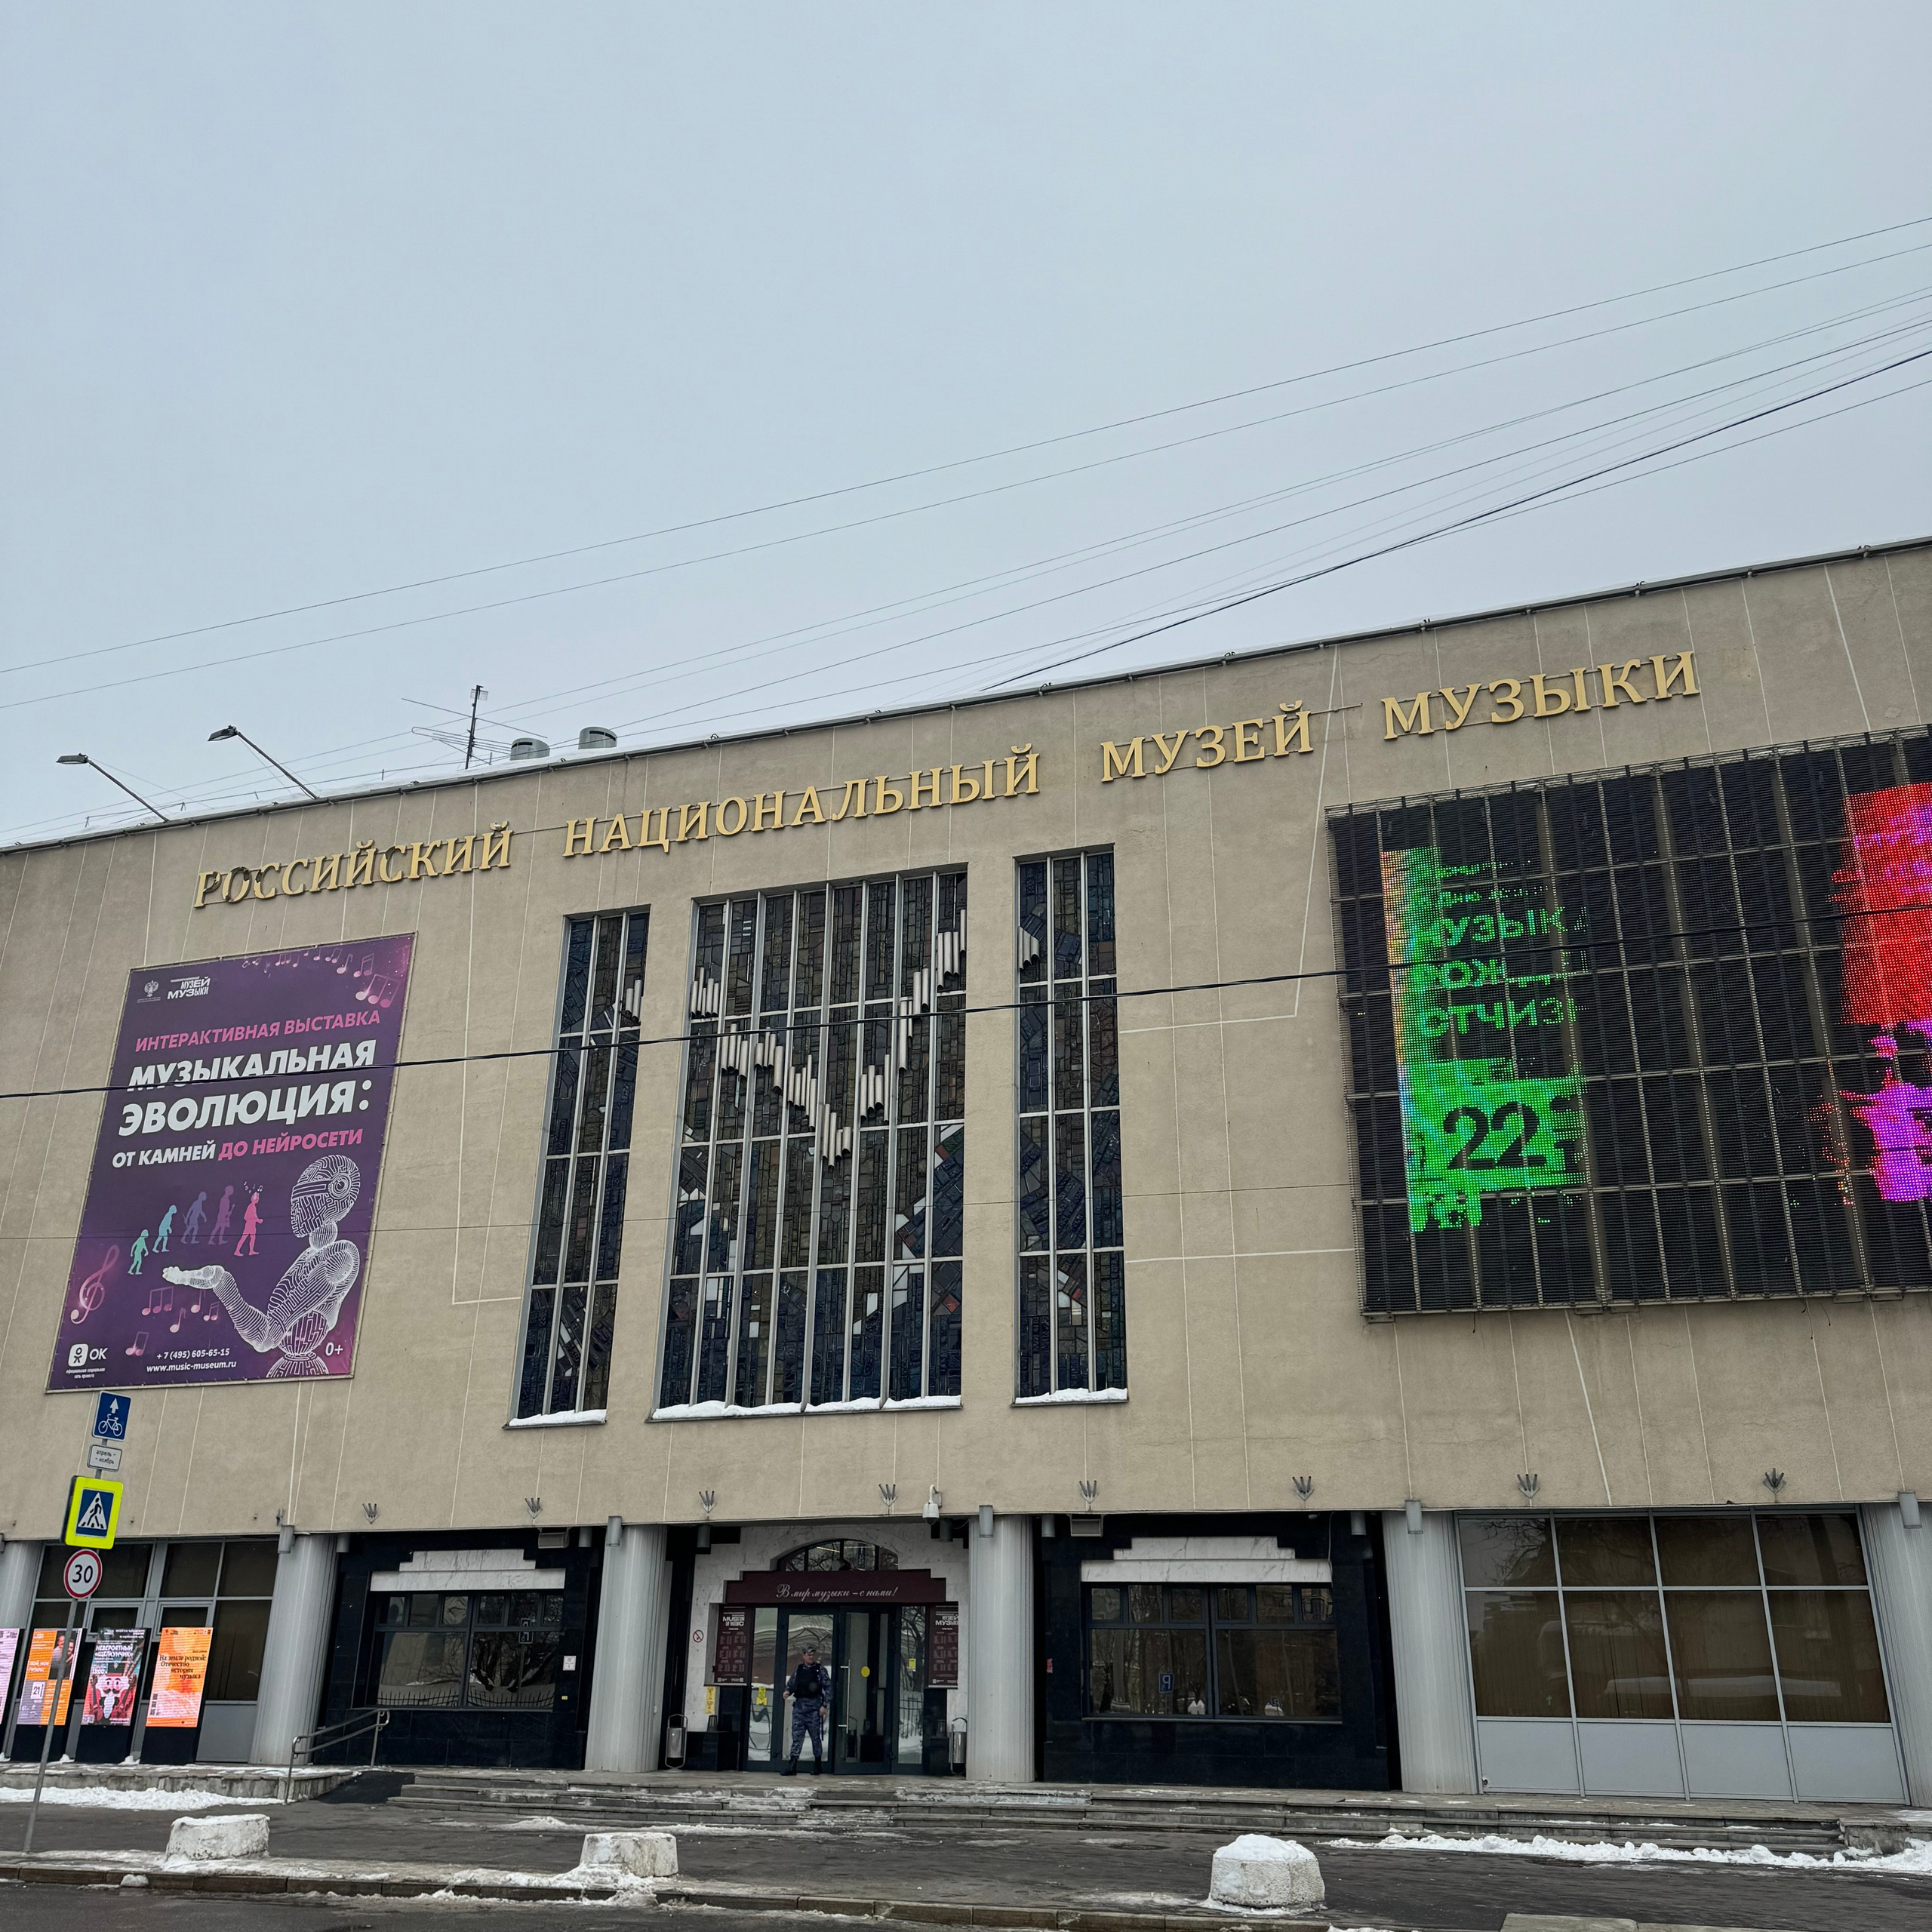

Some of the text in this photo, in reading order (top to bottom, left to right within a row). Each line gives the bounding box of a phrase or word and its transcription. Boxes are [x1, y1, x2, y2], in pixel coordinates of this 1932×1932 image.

[194, 651, 1700, 908] РОССИЙСКИЙ НАЦИОНАЛЬНЫЙ МУЗЕЙ МУЗЫКИ
[180, 976, 211, 989] МУЗЕЙ
[167, 986, 209, 1000] МУЗЫКИ
[135, 1010, 380, 1052] ИНТЕРАКТИВНАЯ ВЫСТАВКА
[127, 1039, 377, 1092] МУЗЫКАЛЬНАЯ
[118, 1079, 372, 1137] ЭВОЛЮЦИЯ:
[1443, 1101, 1546, 1171] 22
[112, 1128, 364, 1168] ОТ КАМНЕЙ ДО НЕЙРОСЕТИ
[170, 1349, 190, 1361] (495)
[192, 1348, 230, 1358] 605-65-15
[325, 1342, 343, 1356] 0+
[146, 1361, 237, 1373] www.music-museum.ru
[72, 1564, 94, 1583] 30
[776, 1583, 790, 1598] В
[791, 1588, 811, 1601] мир
[811, 1589, 850, 1602] музыки
[866, 1586, 899, 1597] нами!
